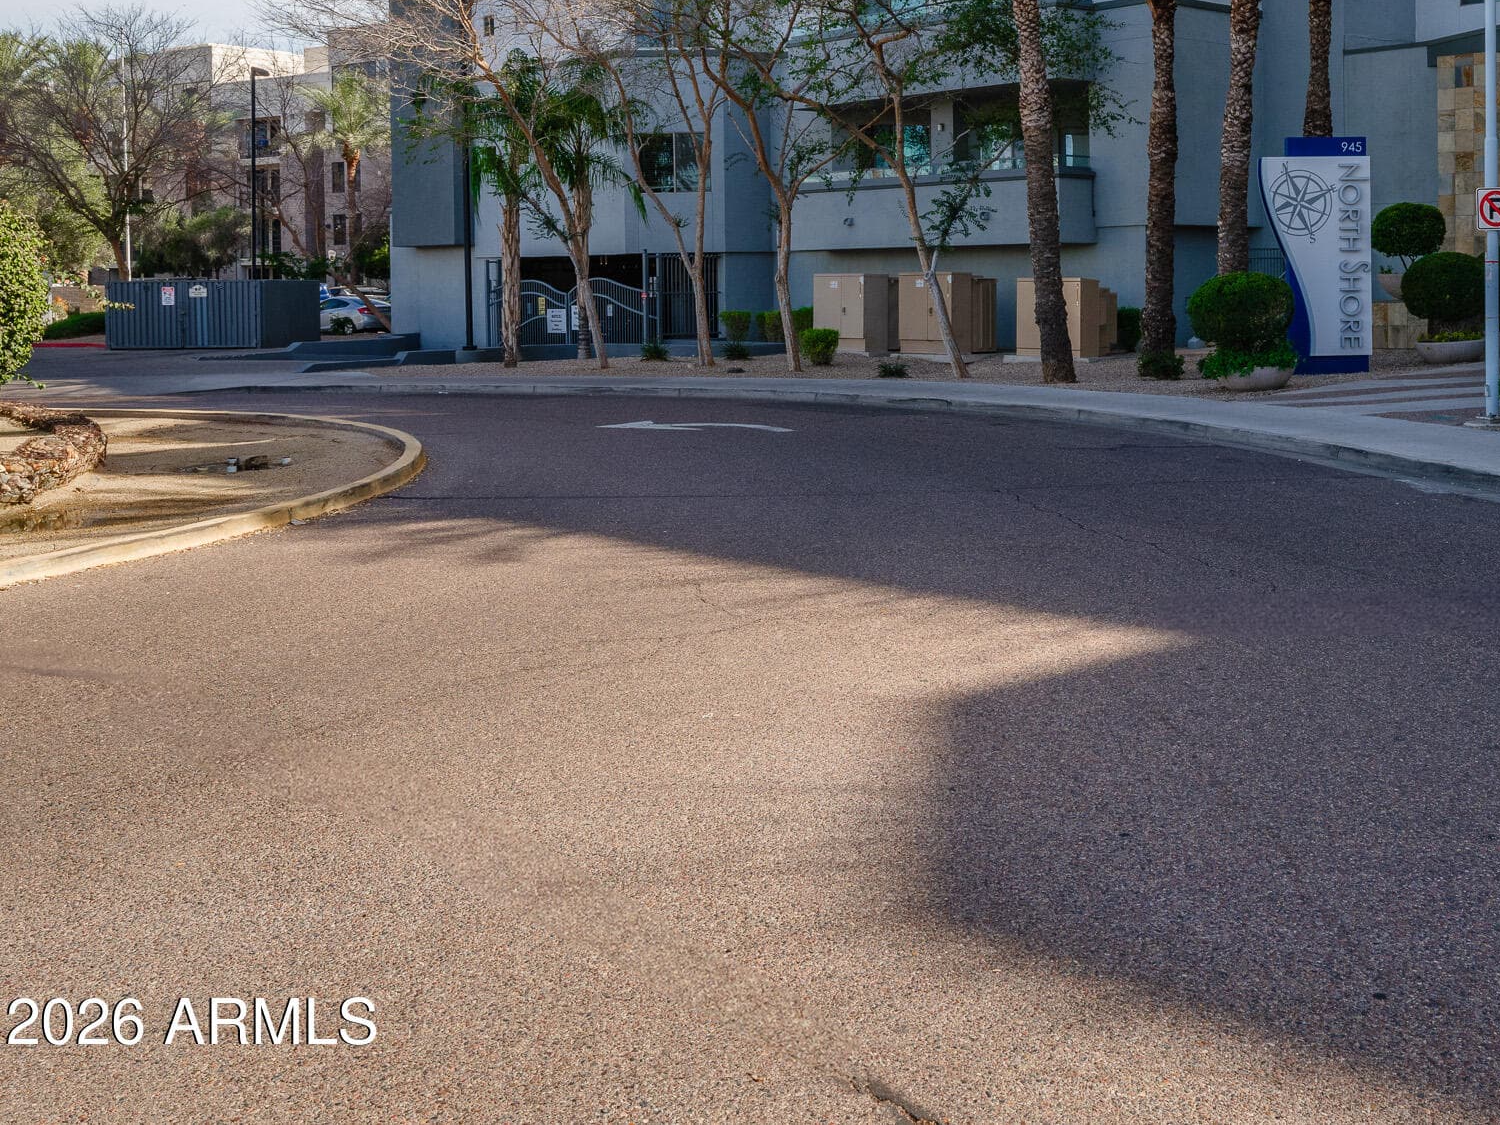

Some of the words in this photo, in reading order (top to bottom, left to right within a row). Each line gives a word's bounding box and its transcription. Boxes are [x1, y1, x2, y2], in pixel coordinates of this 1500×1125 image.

[1341, 141, 1363, 153] 945
[1338, 163, 1369, 253] NORTH
[1339, 260, 1371, 350] SHORE
